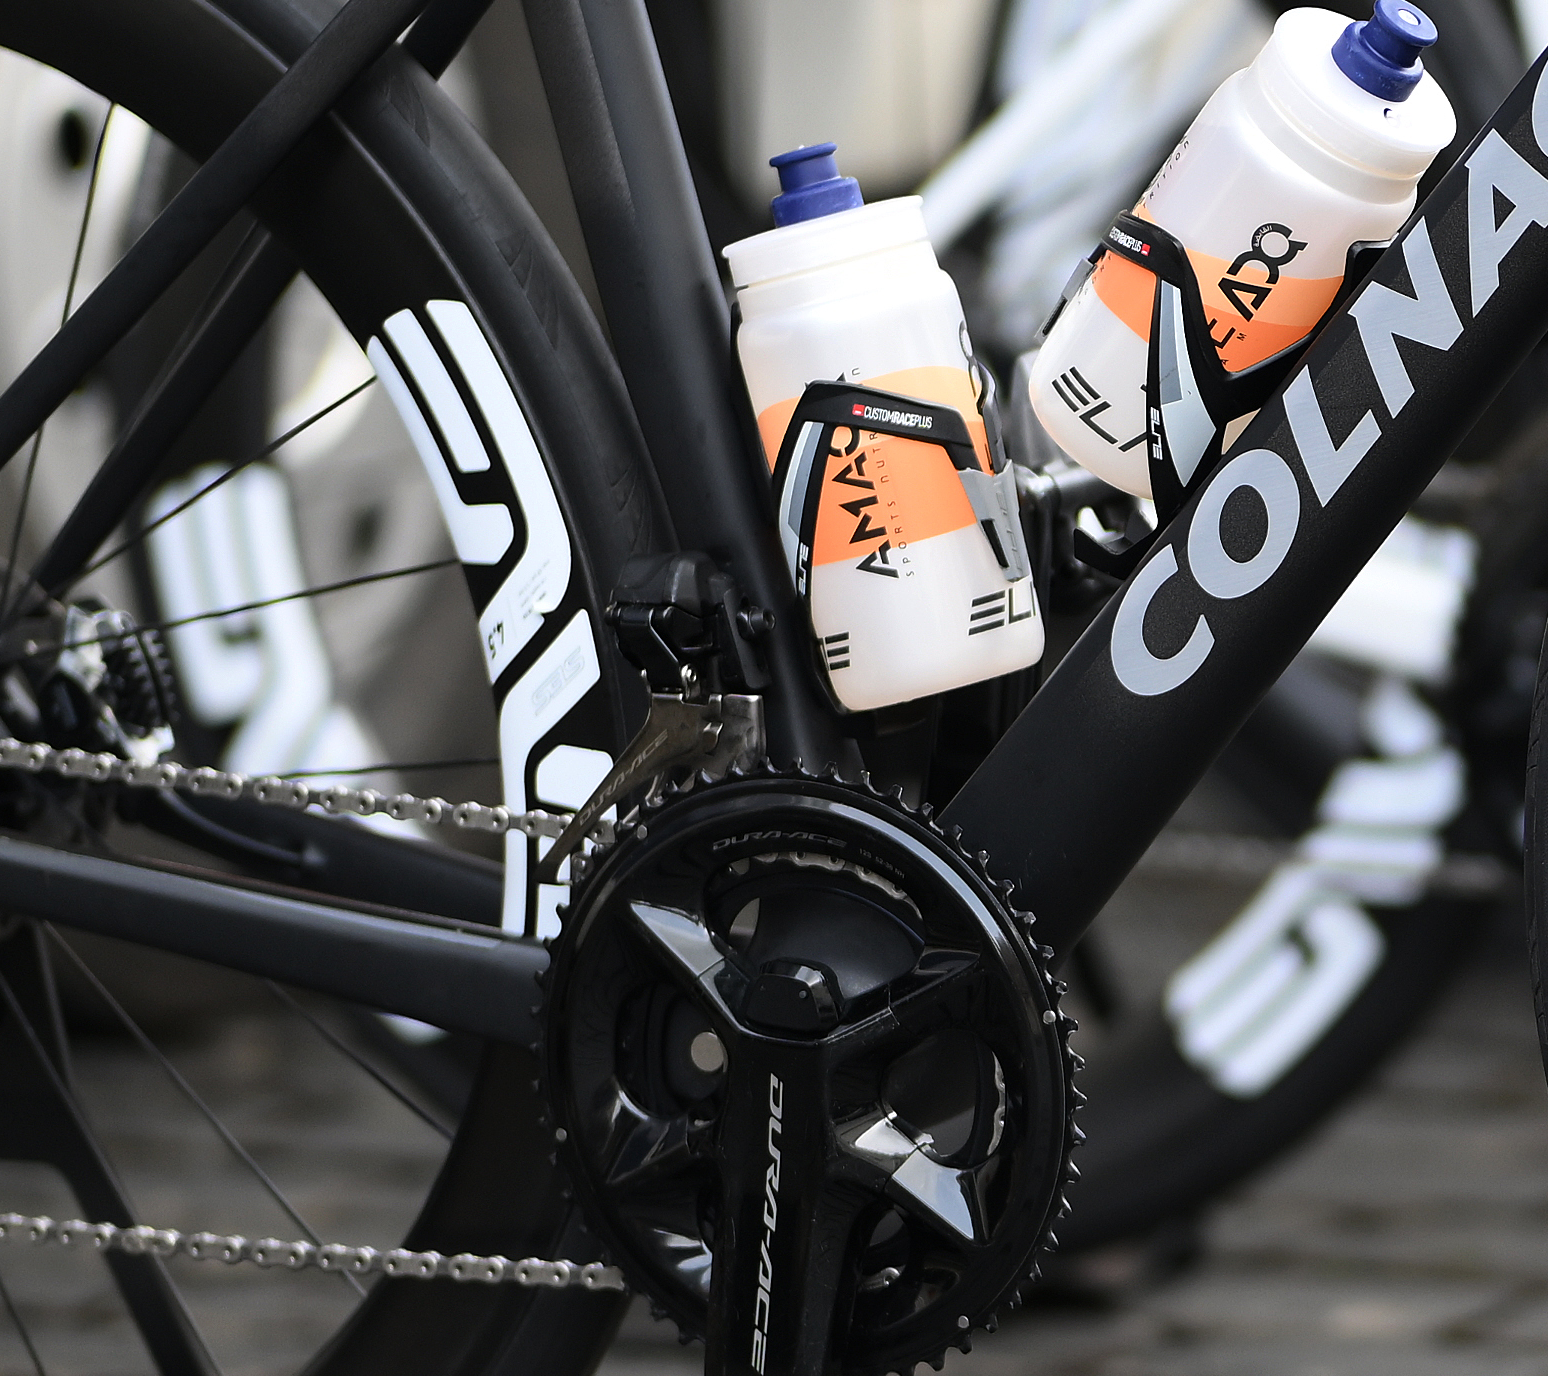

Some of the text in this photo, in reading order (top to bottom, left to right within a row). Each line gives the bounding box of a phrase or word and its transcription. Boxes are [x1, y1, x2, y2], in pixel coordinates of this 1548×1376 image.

[863, 406, 933, 429] CUSTOMRACEPLUS
[887, 500, 915, 578] SPORTS
[488, 621, 505, 661] 4.5
[531, 645, 586, 717] SES
[579, 729, 669, 827] DURA-ACE
[712, 830, 848, 851] DURA-ACE
[752, 1074, 783, 1376] DURA-ACE
